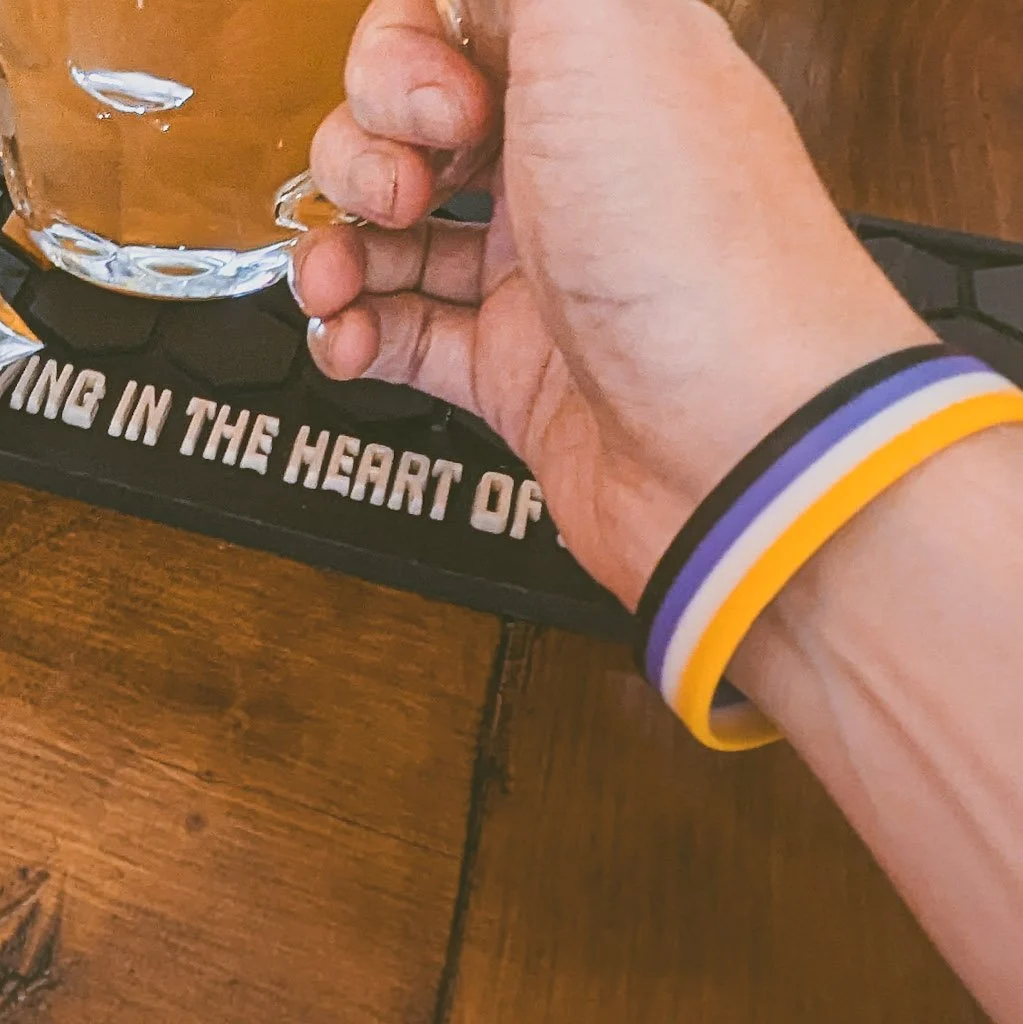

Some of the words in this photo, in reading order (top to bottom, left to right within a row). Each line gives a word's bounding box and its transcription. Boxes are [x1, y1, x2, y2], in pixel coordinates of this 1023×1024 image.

[108, 380, 172, 446] IN
[179, 397, 280, 475] THE
[283, 425, 463, 521] HEART
[470, 471, 543, 540] OF
